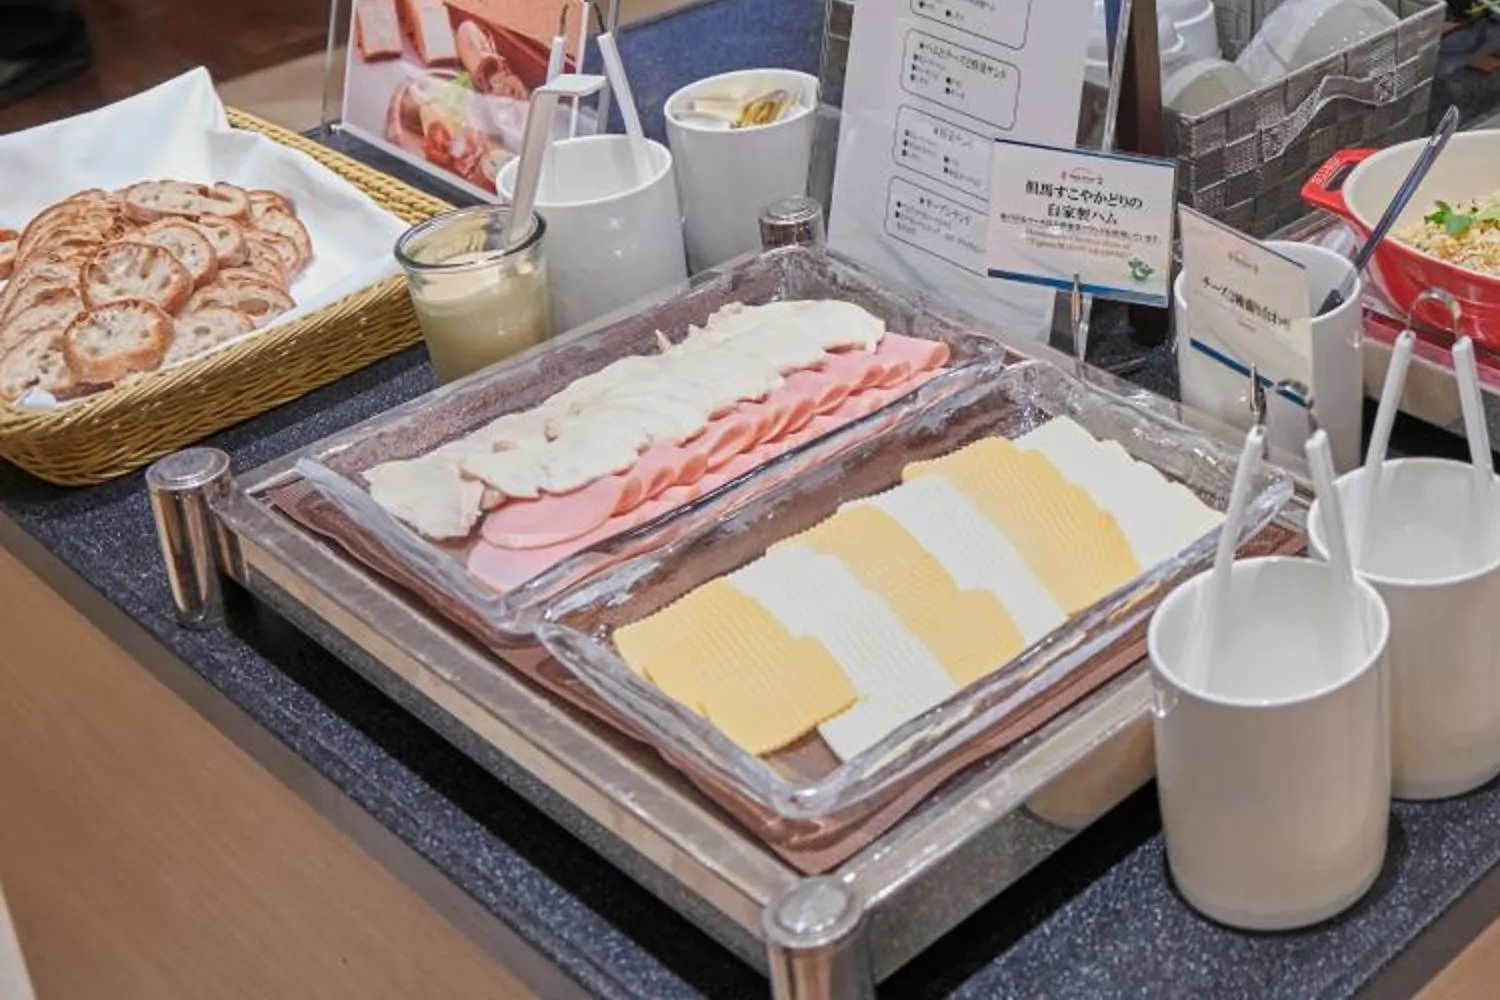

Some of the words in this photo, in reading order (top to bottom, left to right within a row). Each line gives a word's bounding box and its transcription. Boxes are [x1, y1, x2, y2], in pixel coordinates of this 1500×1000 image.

[1026, 180, 1143, 210] 但馬すこやかどりの
[1047, 203, 1118, 225] 自家製ハム
